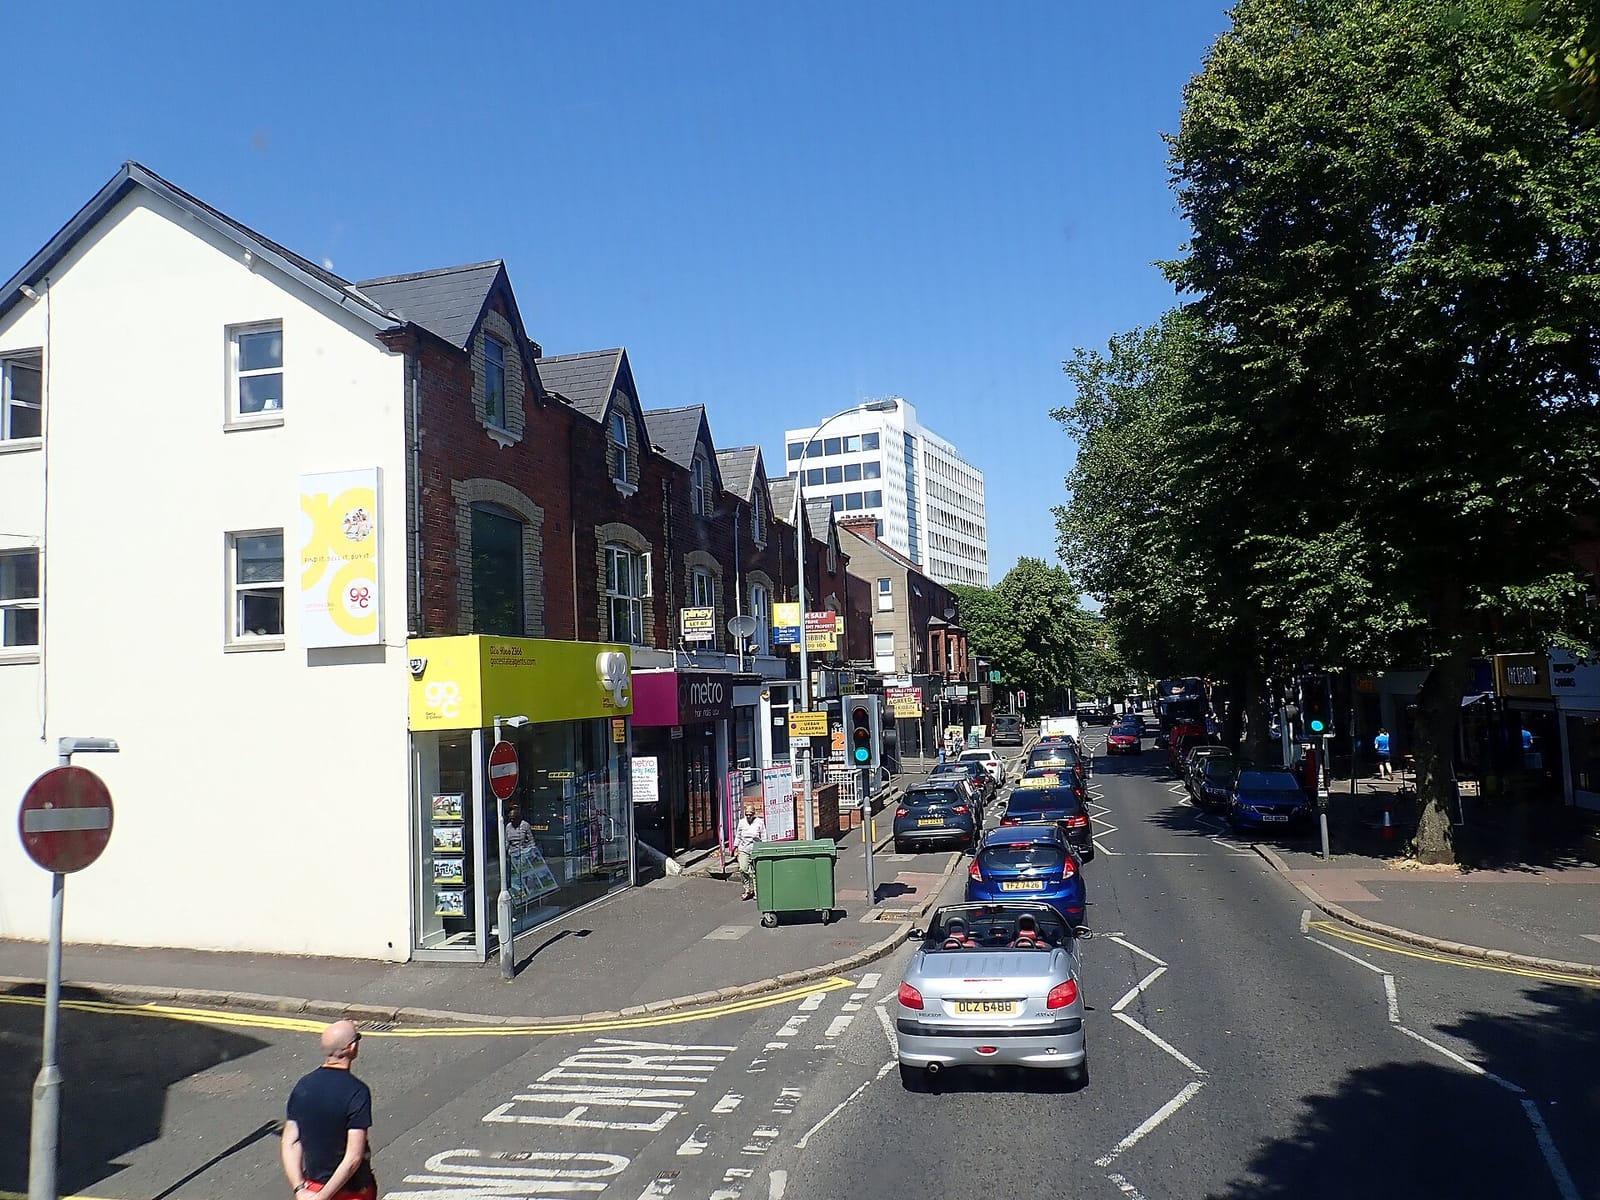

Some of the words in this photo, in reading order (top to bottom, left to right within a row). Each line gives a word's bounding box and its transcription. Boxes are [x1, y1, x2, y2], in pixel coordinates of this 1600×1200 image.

[690, 677, 724, 705] metro
[958, 1002, 980, 1013] OCZ
[984, 1001, 1013, 1013] 6488
[481, 1037, 739, 1132] ENTRY
